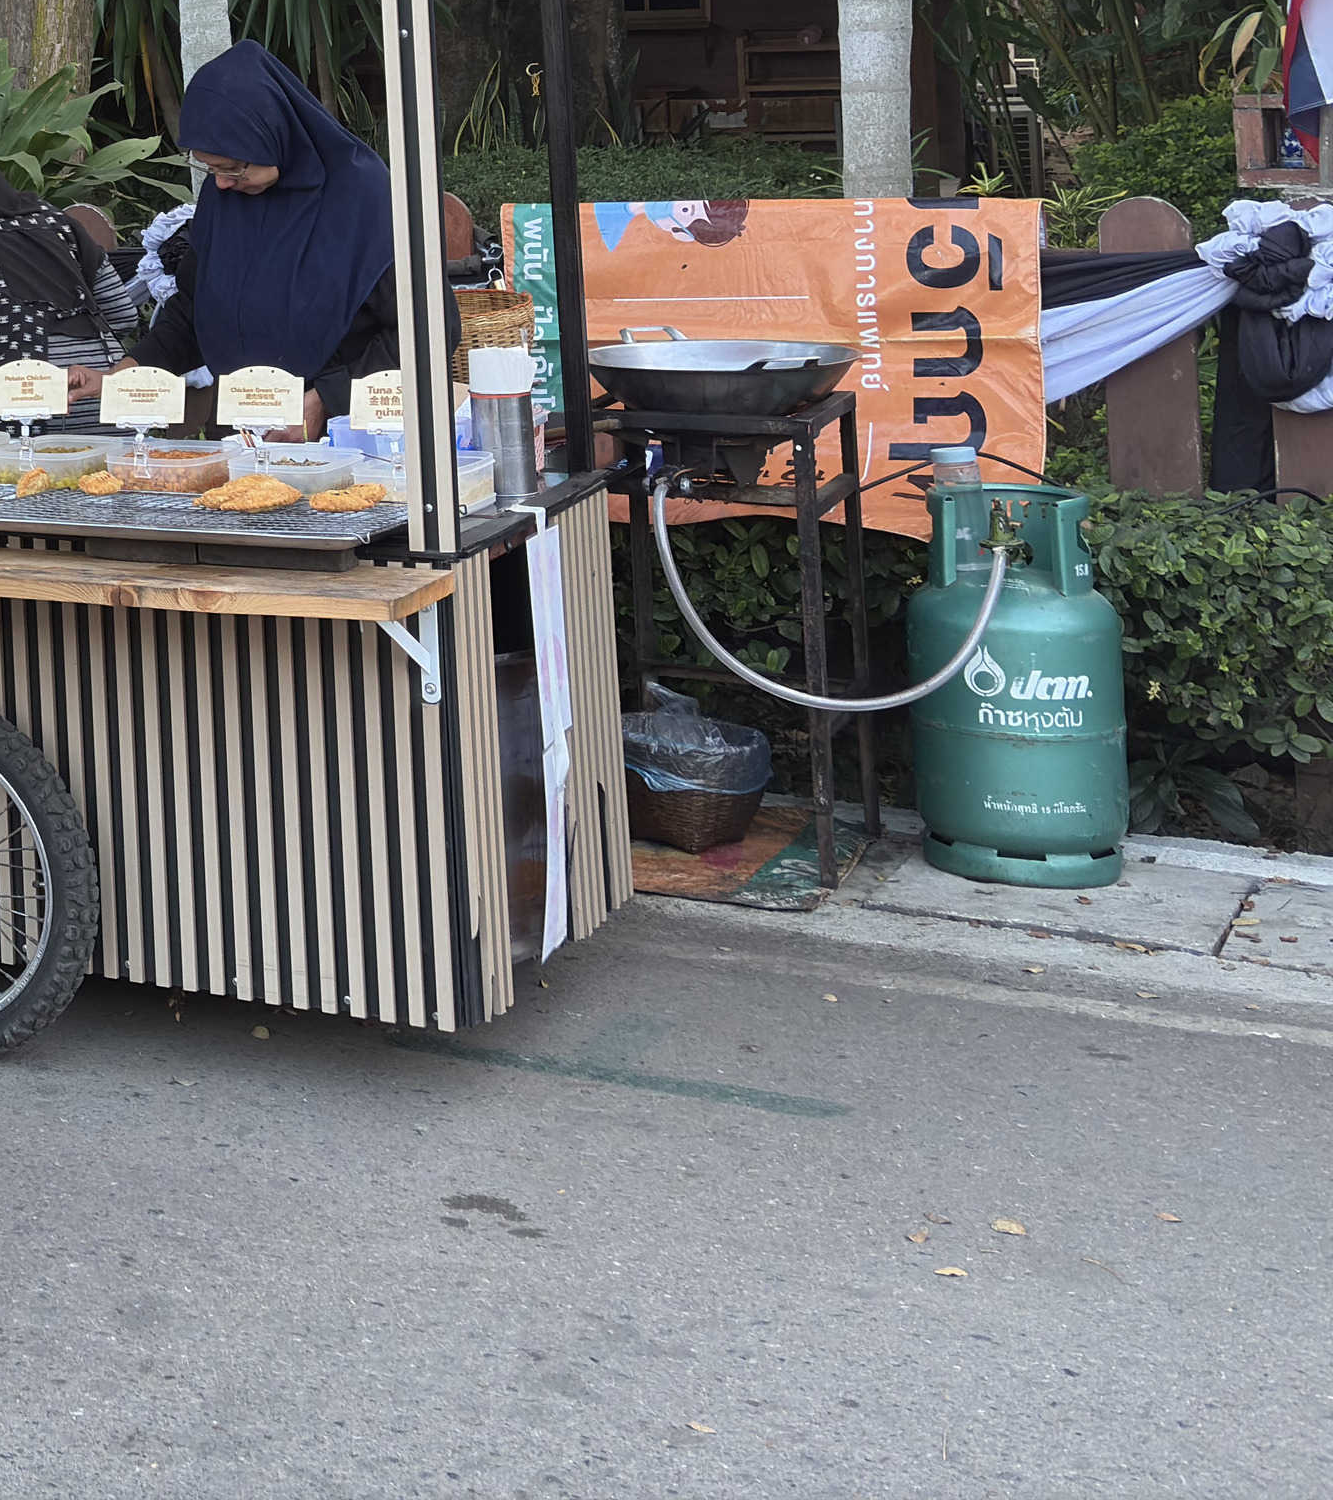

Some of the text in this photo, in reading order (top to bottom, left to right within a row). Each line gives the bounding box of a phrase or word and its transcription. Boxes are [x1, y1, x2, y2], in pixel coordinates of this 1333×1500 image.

[367, 386, 392, 394] Tuna
[1009, 669, 1093, 701] ปตท.
[978, 702, 1083, 733] ก๊าซหุงต้ม
[983, 794, 1038, 816] น้ำหนักสุทธิ
[1041, 806, 1051, 814] 15
